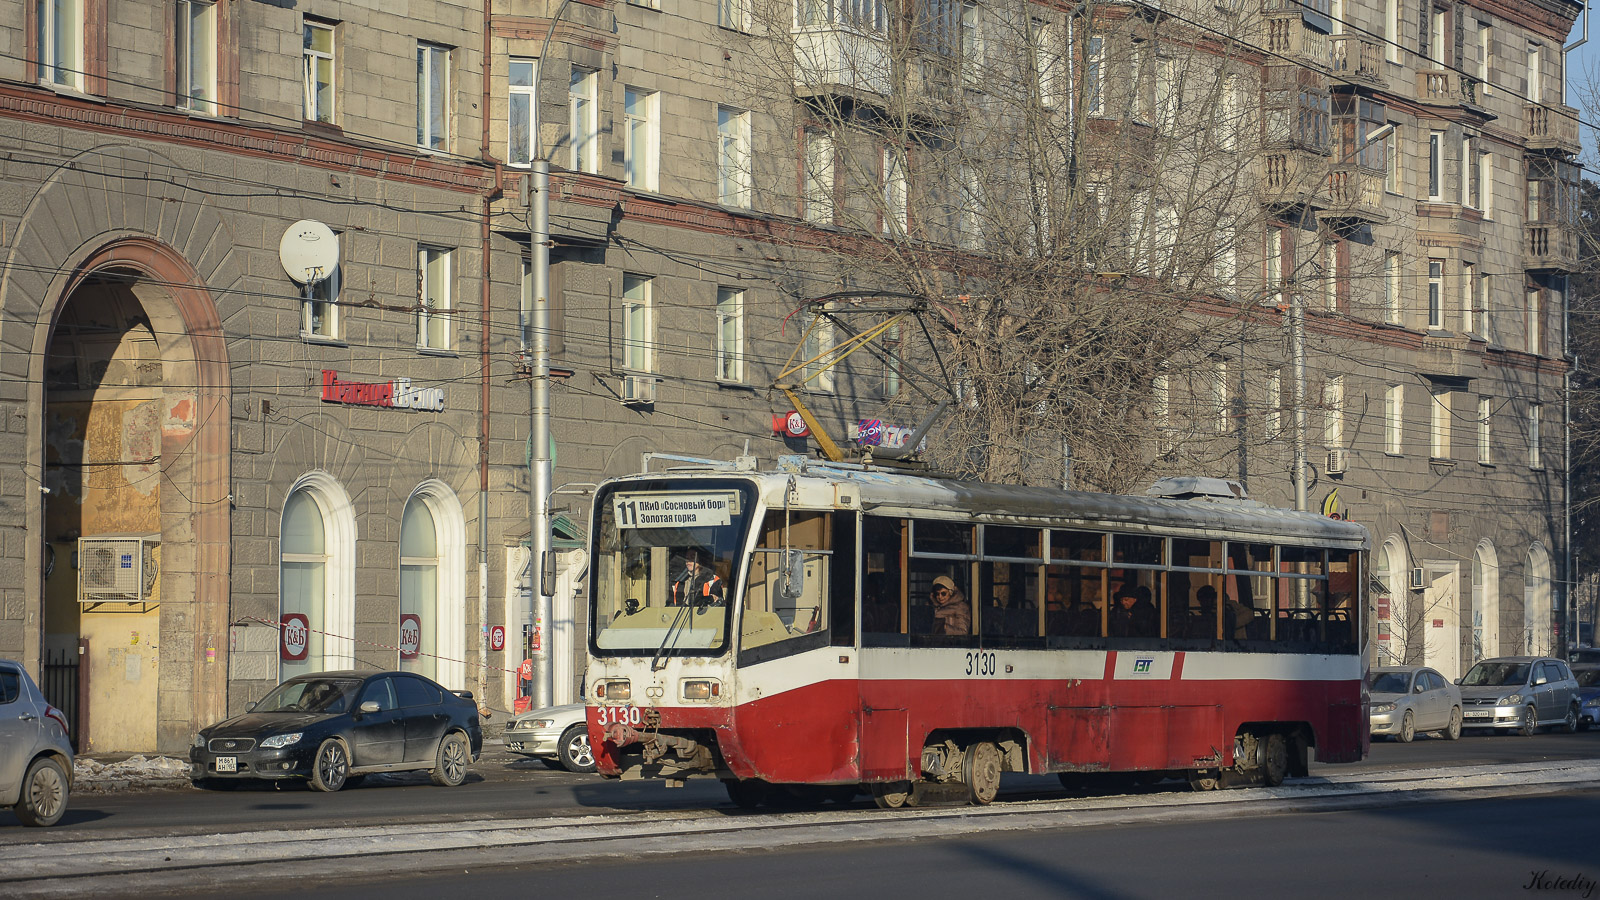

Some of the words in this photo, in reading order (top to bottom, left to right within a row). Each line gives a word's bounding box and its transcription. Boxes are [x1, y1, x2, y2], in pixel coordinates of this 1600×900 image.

[617, 501, 636, 525] 11
[639, 501, 660, 511] ПКиО
[661, 499, 706, 511] «Сосновый
[640, 513, 673, 524] Золотая
[674, 513, 697, 523] горка
[287, 628, 304, 646] К&Б
[400, 628, 418, 645] К&Б
[965, 652, 996, 676] 3130
[597, 707, 641, 725] 3130
